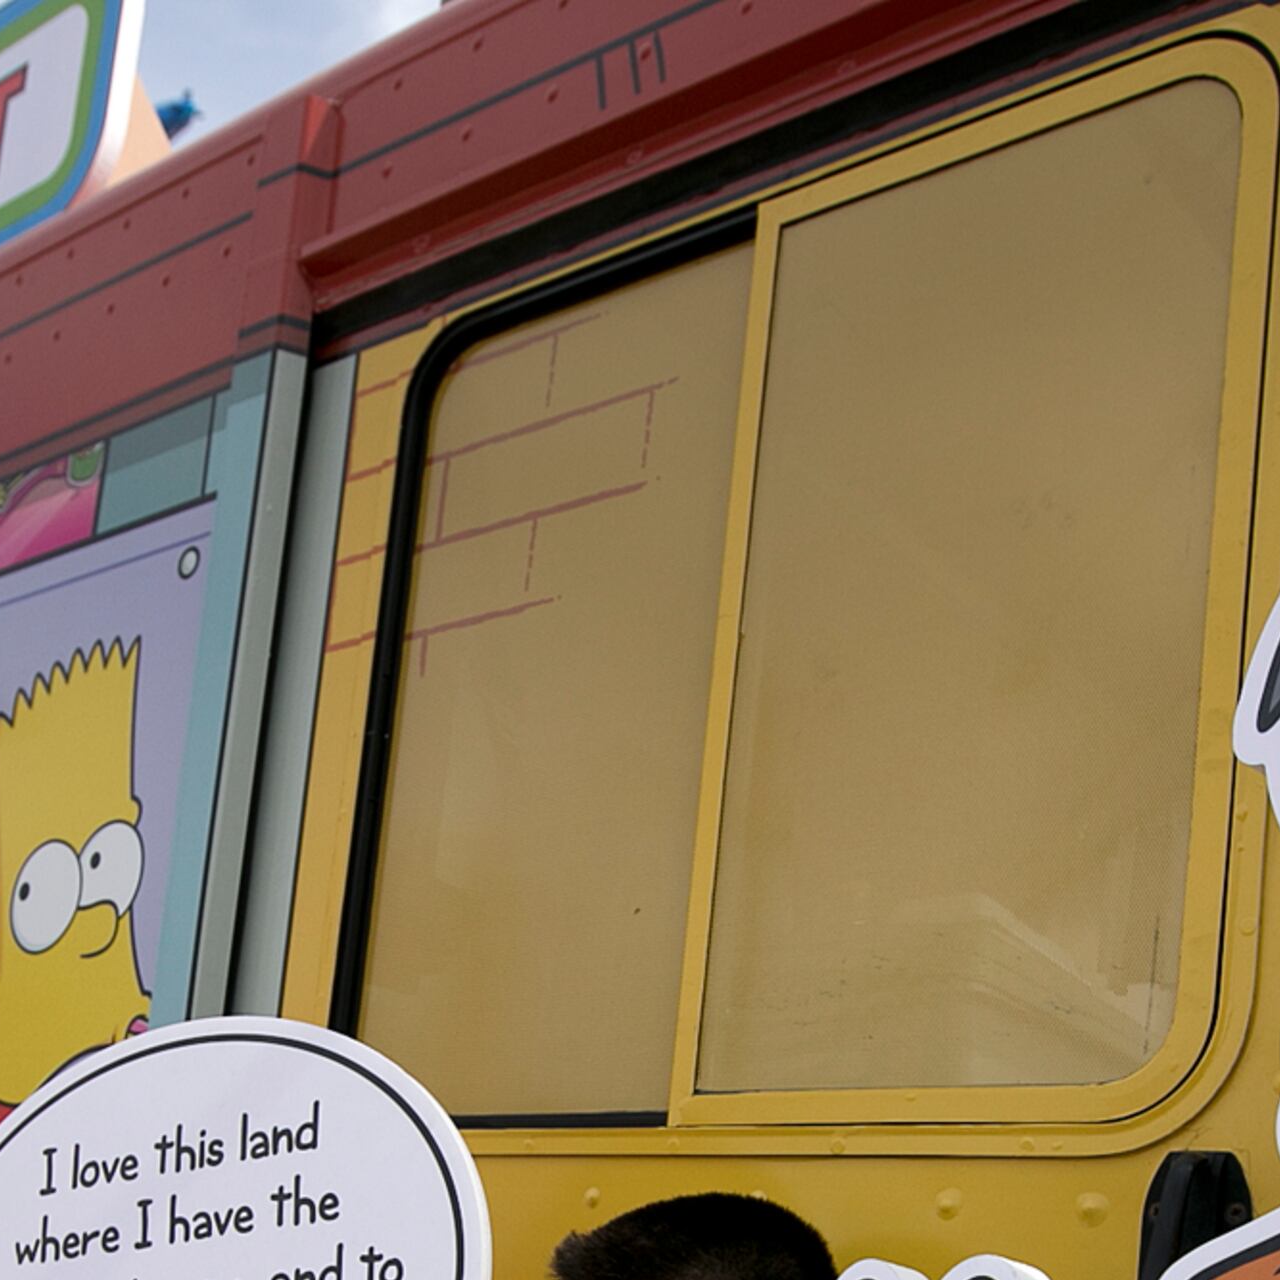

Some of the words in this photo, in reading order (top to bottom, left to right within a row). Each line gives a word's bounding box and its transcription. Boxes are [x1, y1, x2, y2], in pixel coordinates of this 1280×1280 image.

[38, 1146, 59, 1197] I
[70, 1142, 140, 1191] love
[153, 1123, 225, 1176] this
[239, 1099, 321, 1162] land
[14, 1214, 121, 1266] where
[133, 1198, 154, 1251] I
[168, 1193, 255, 1246] have
[269, 1173, 341, 1228] the
